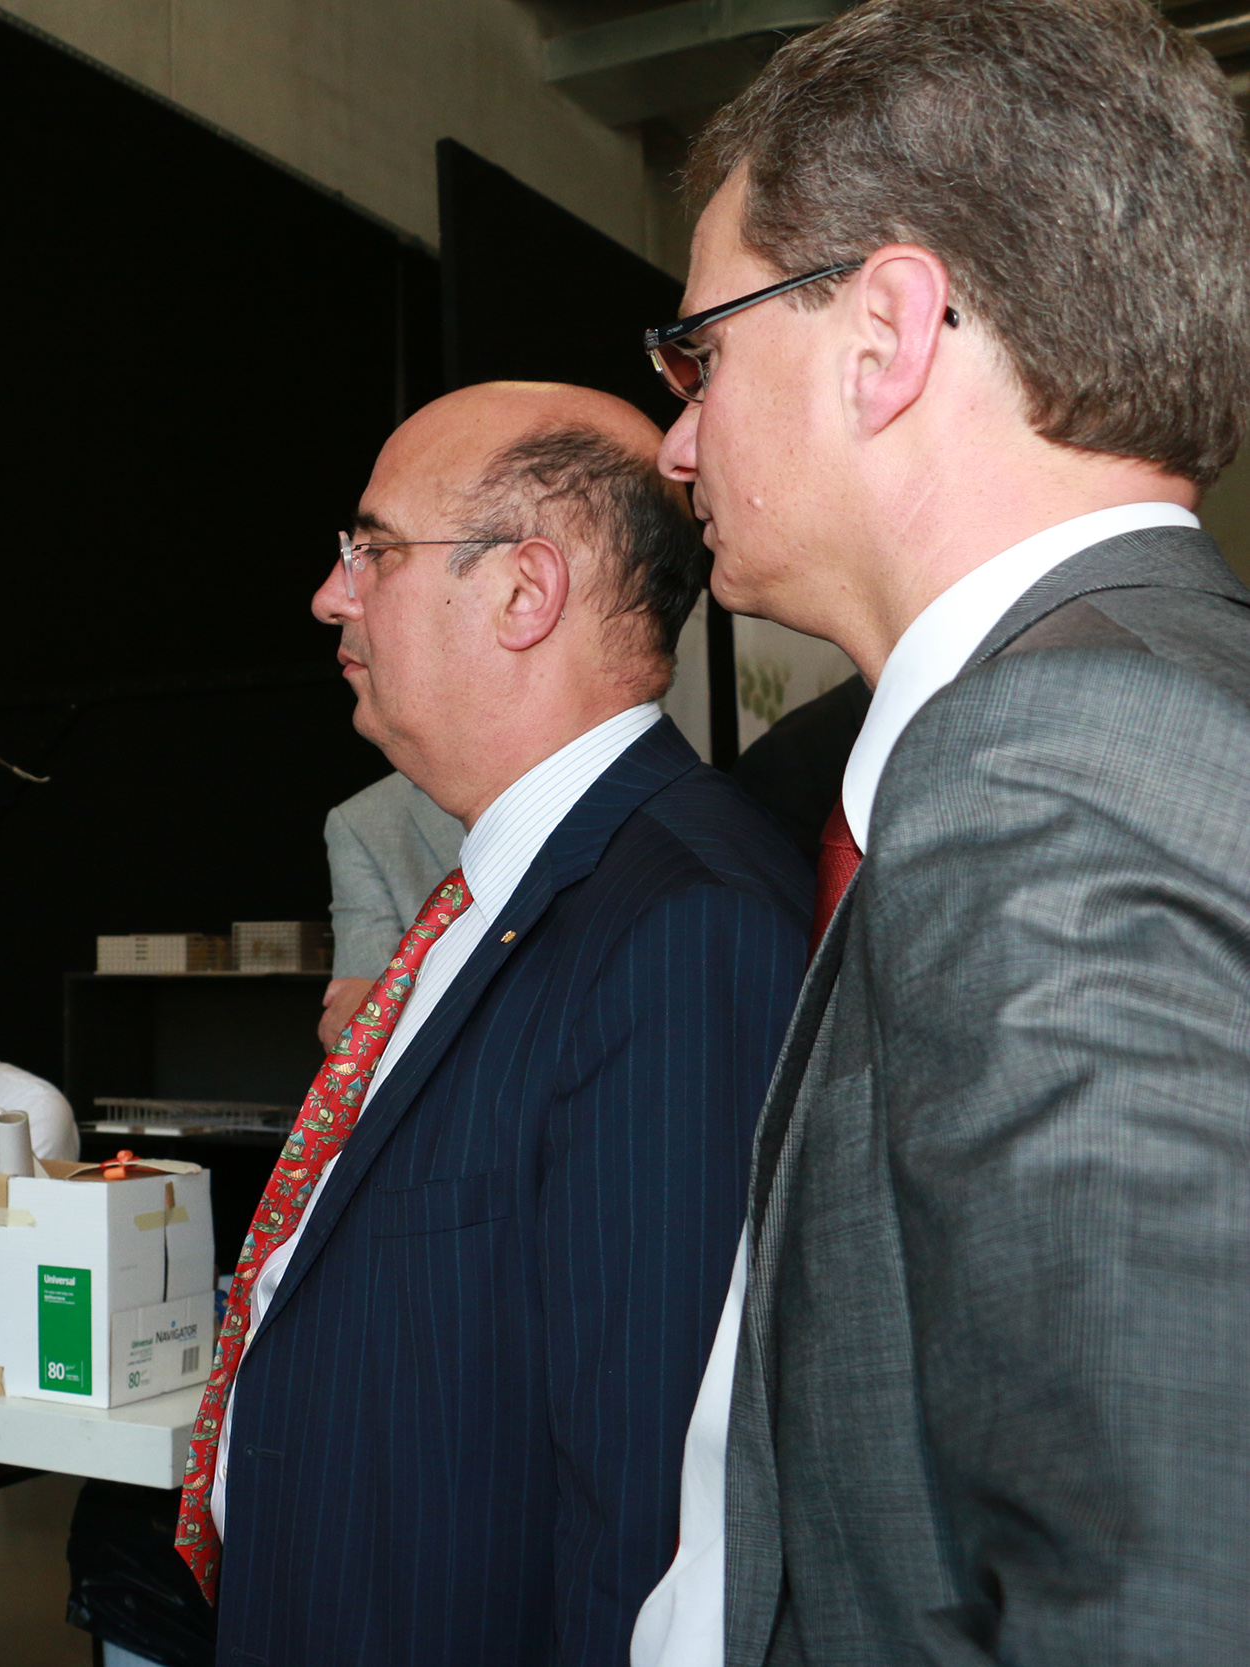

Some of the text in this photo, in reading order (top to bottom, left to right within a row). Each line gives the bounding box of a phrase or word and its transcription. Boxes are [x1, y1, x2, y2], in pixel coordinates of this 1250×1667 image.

[43, 1274, 76, 1286] Universal
[155, 1324, 197, 1343] NAVIGATOR
[47, 1361, 65, 1380] 80
[128, 1371, 140, 1389] 80
